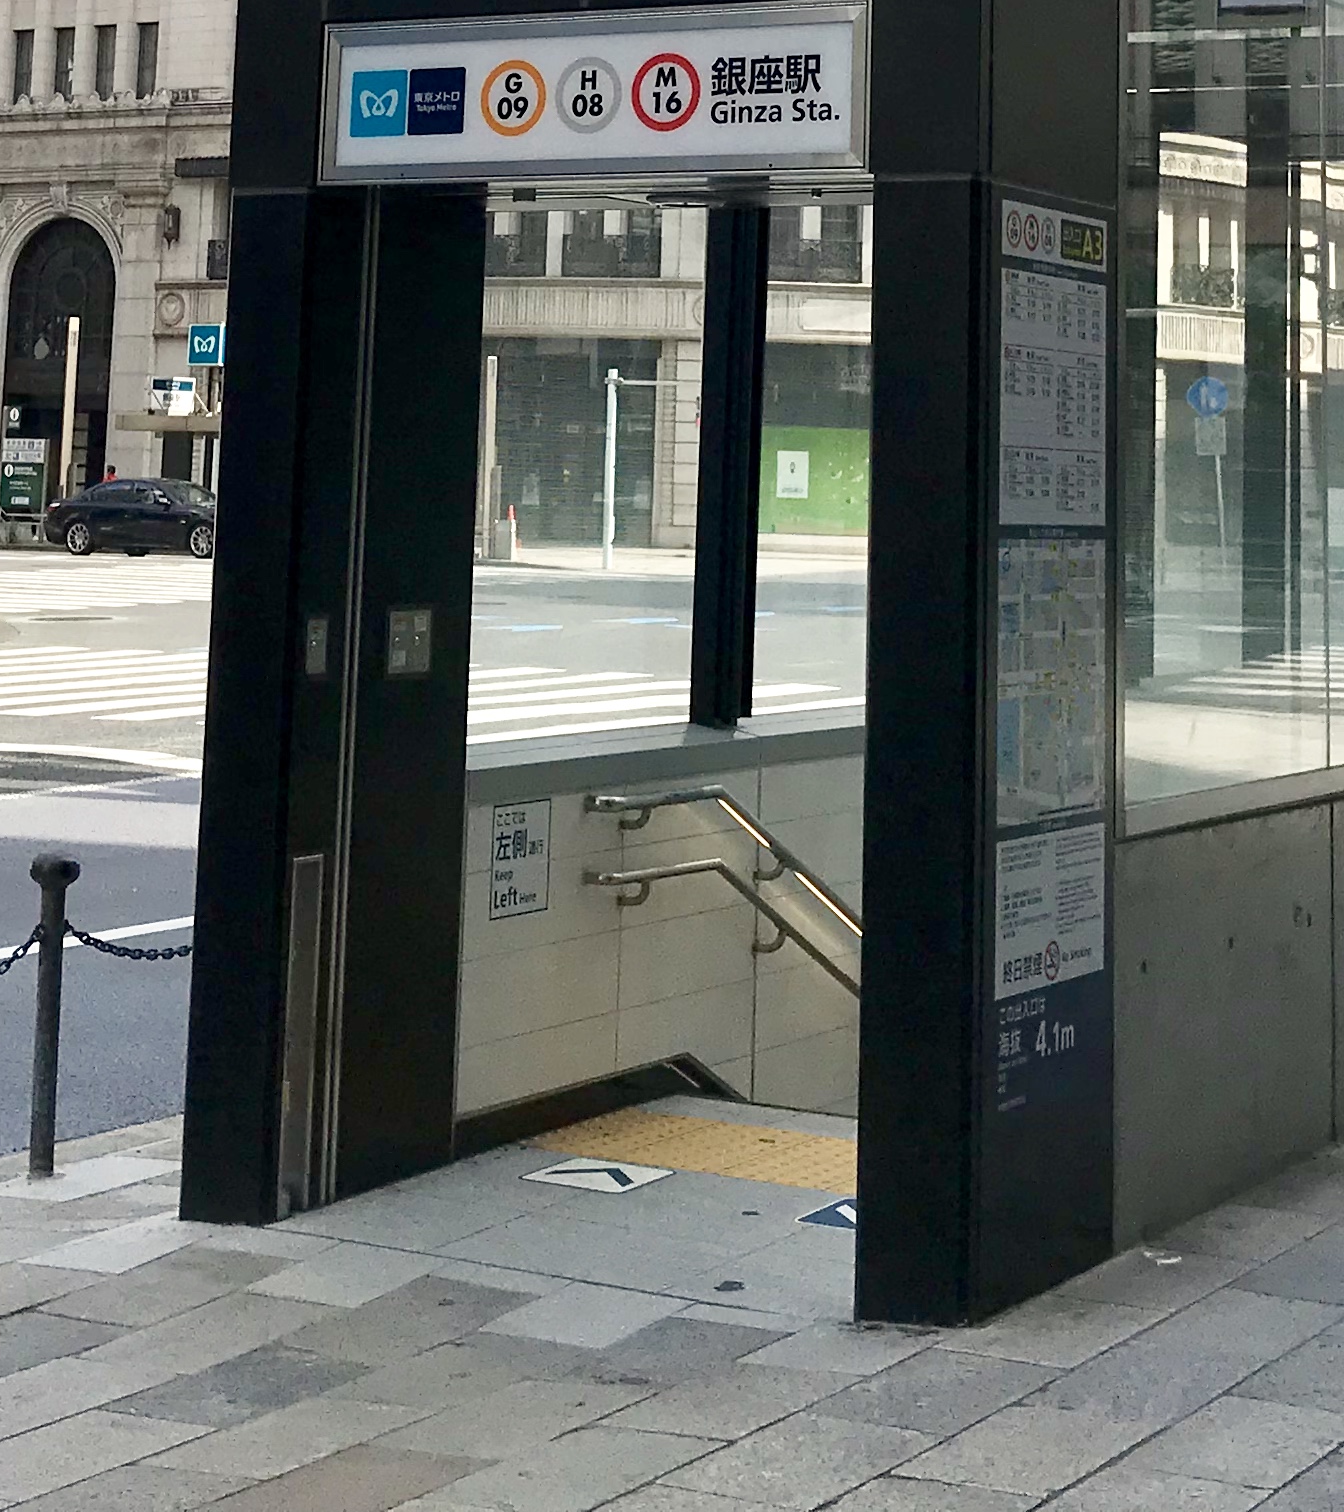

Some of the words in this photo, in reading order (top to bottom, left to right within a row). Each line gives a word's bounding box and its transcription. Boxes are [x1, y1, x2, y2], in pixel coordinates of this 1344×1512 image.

[505, 72, 523, 93] G
[580, 70, 597, 90] H
[655, 67, 677, 88] M
[711, 54, 822, 96] 銀座駅
[414, 91, 460, 103] 東京メトロ
[416, 104, 435, 113] Tokyo
[437, 103, 457, 112] Metro
[497, 96, 529, 119] 09
[571, 93, 603, 117] 08
[653, 91, 682, 114] 16
[710, 100, 782, 124] Ginza
[792, 98, 840, 122] Sta.
[1082, 227, 1102, 260] A3
[496, 810, 526, 827] ここでは
[494, 885, 518, 910] Left
[1035, 1019, 1075, 1058] 4.1m
